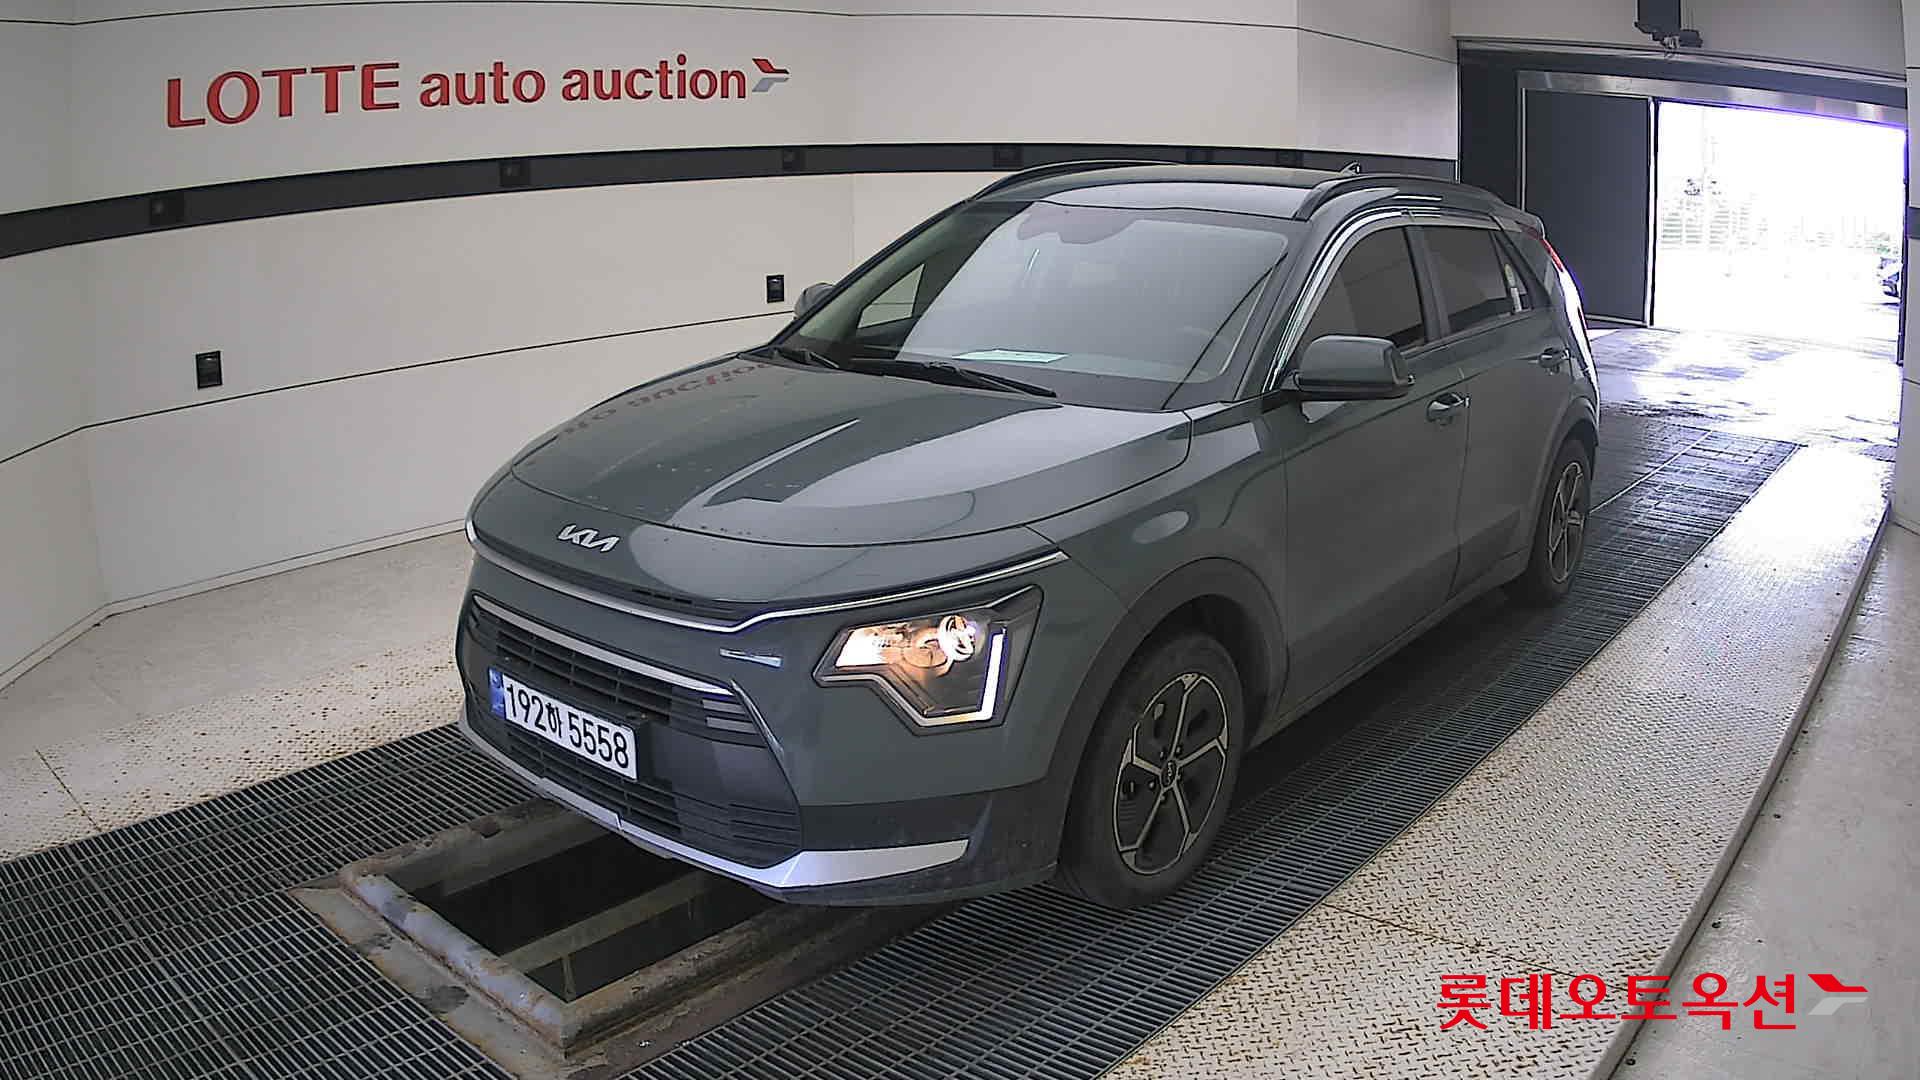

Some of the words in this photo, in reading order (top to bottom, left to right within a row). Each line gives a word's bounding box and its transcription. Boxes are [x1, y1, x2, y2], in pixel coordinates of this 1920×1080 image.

[166, 62, 400, 128] LOTTE
[419, 61, 546, 108] auto
[561, 54, 747, 101] auction
[557, 523, 620, 552] KIA
[567, 711, 630, 769] 5558
